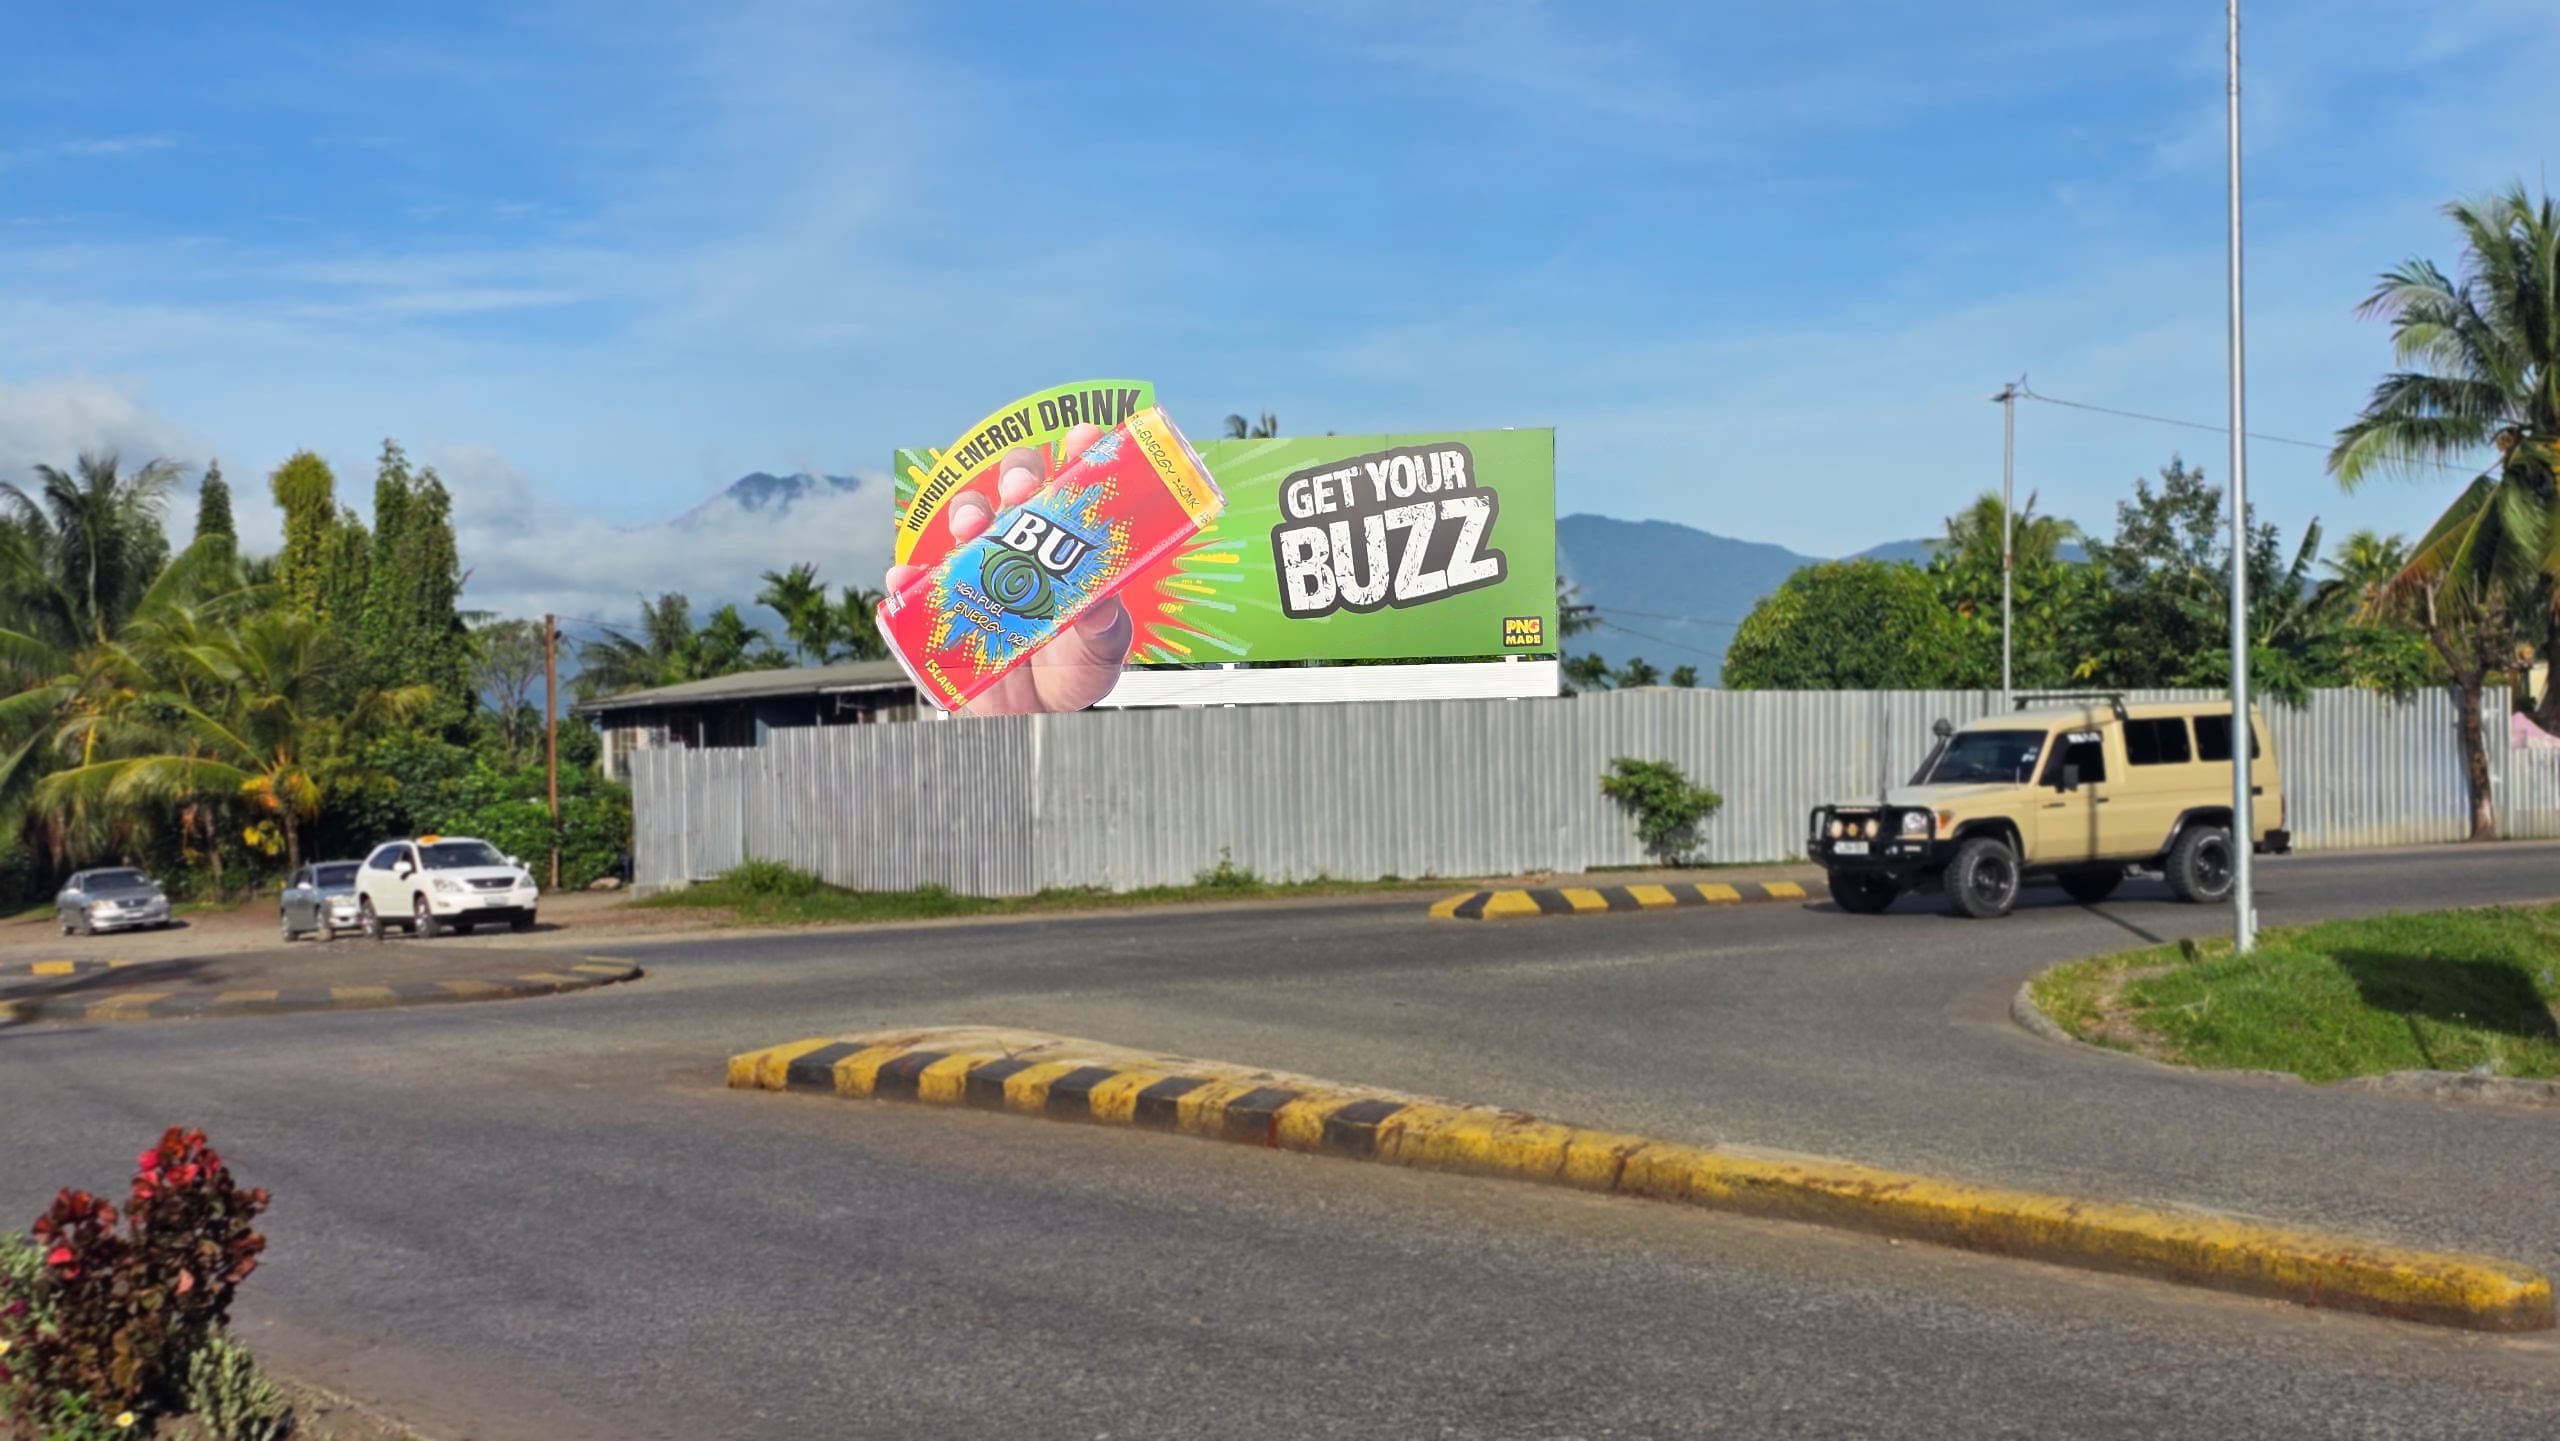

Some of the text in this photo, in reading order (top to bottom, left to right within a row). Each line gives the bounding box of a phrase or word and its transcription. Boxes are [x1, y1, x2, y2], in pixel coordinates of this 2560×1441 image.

[954, 407, 1034, 471] ENERGY
[1038, 388, 1142, 432] DRINK
[1140, 430, 1176, 475] ENERGY
[1287, 450, 1467, 519] GET YOUR
[1002, 512, 1086, 571] BU
[1280, 495, 1499, 611] BUZZ
[954, 601, 1006, 634] ENERGY
[976, 593, 1005, 617] FUEL
[1506, 619, 1540, 634] PNG
[1505, 634, 1541, 645] MADE
